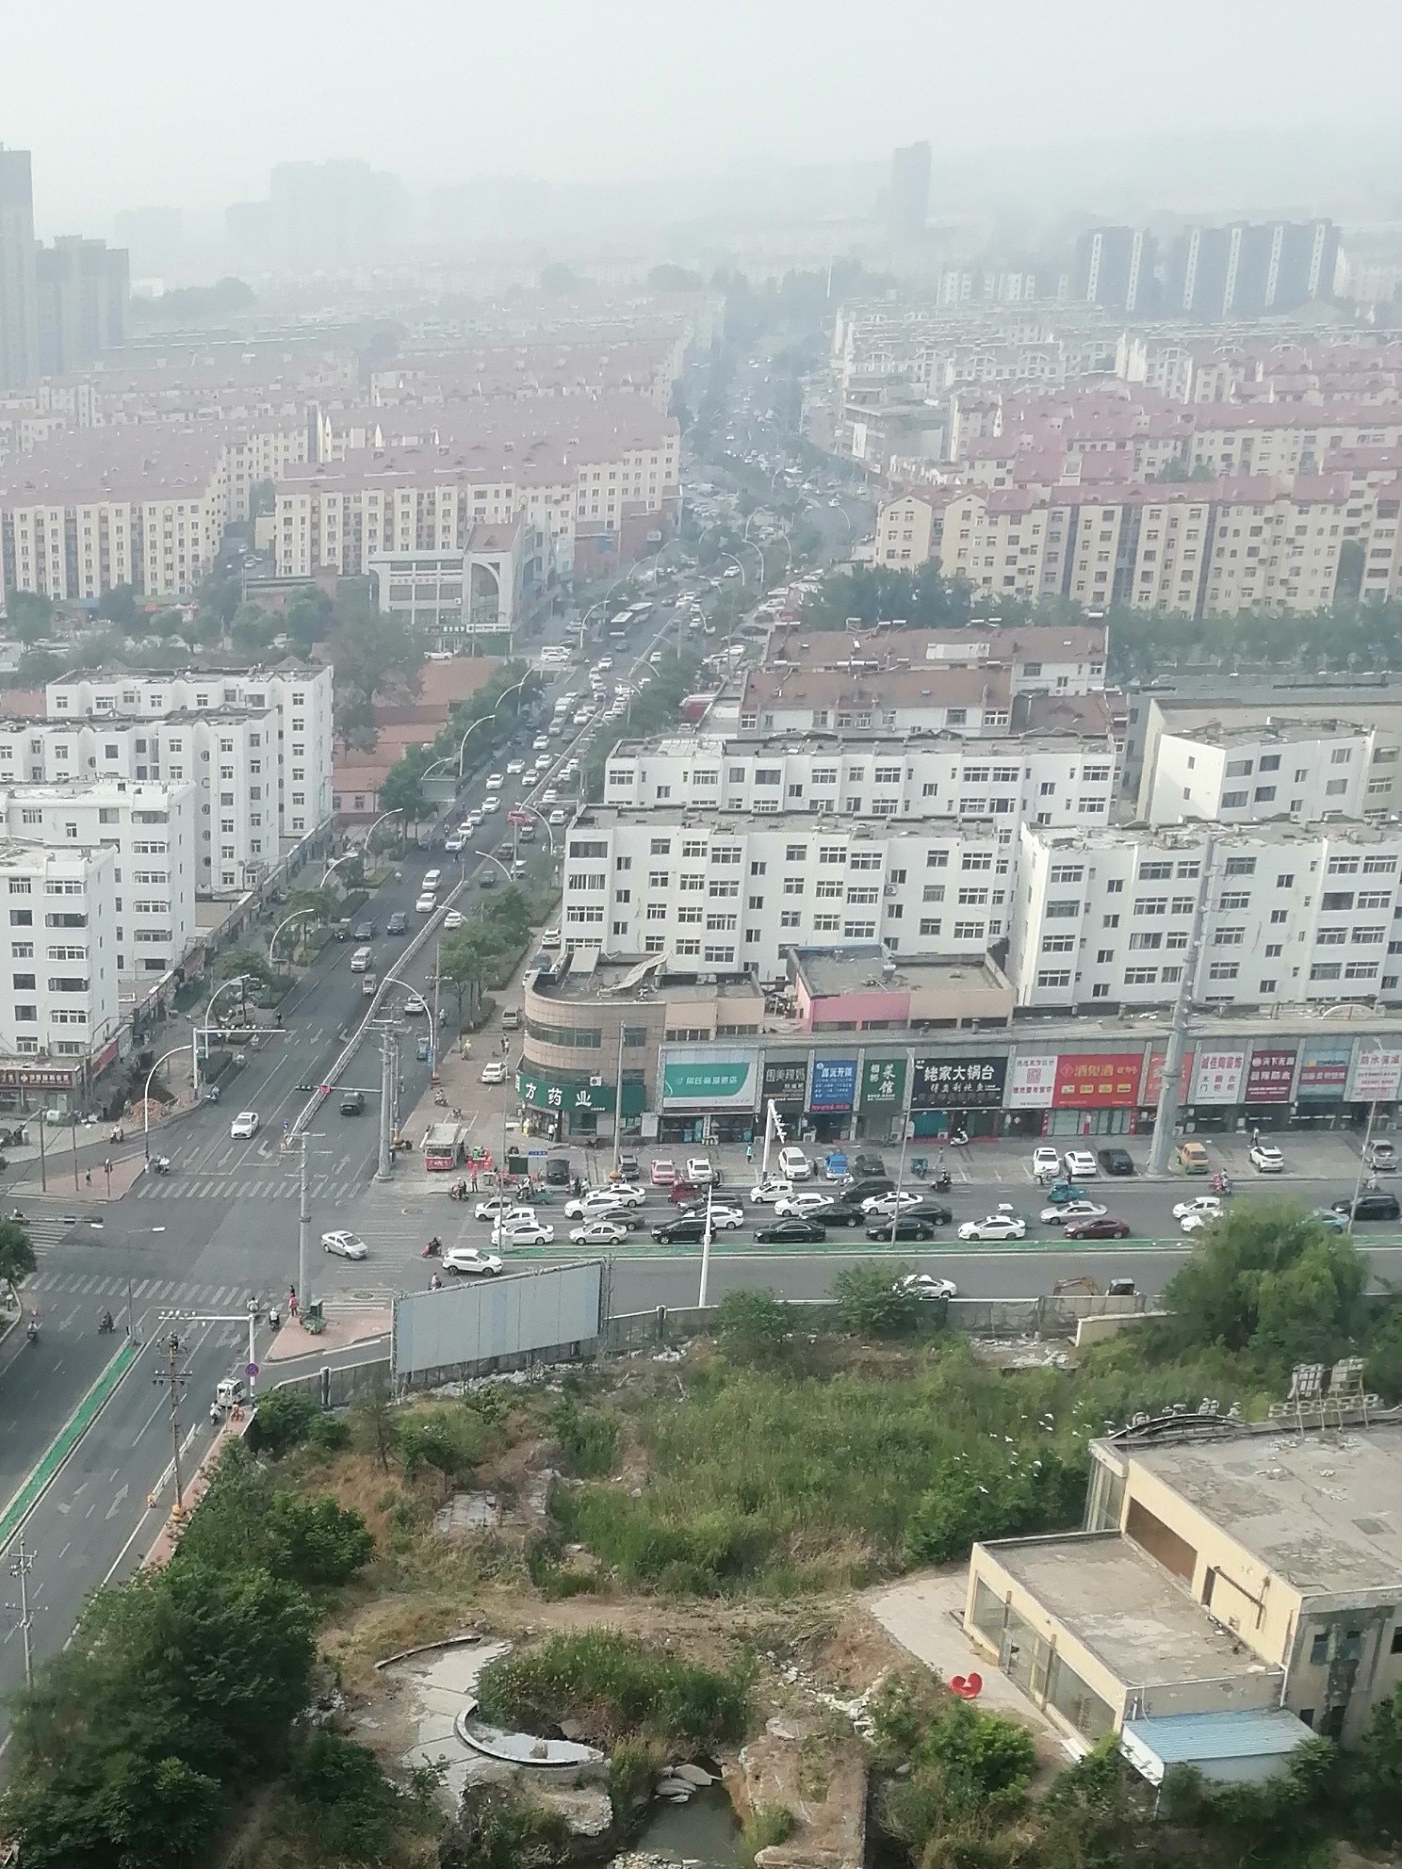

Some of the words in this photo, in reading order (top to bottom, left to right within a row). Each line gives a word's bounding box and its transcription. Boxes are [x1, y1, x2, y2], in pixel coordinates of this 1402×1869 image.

[924, 1064, 995, 1082] 姥家大锅台
